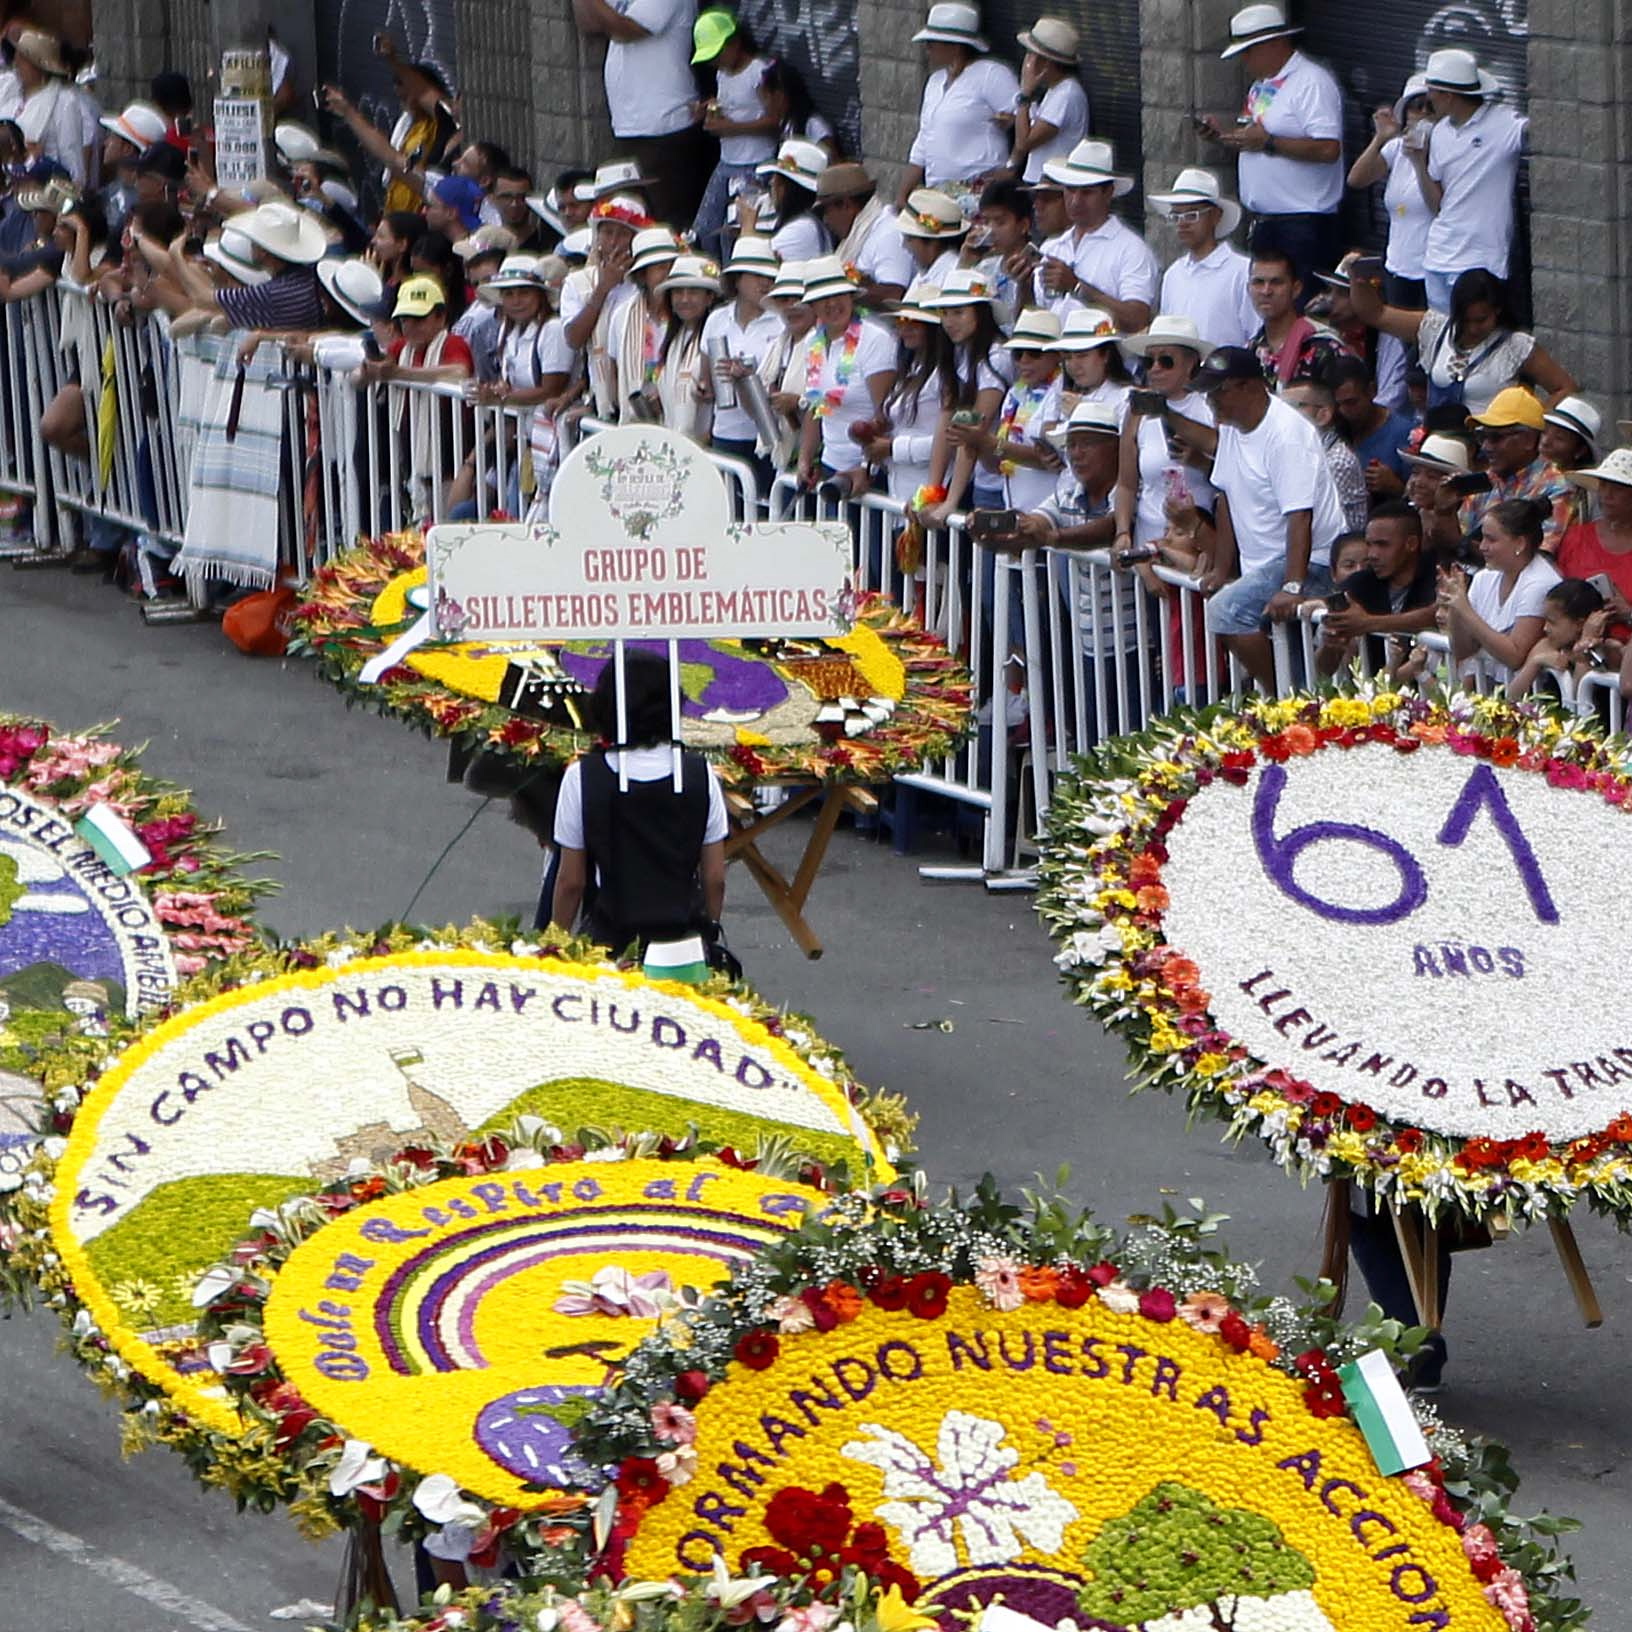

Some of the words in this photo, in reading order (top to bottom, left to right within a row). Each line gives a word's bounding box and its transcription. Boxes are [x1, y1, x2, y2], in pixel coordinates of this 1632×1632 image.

[584, 548, 666, 583] GRUPO
[676, 547, 708, 581] DE
[466, 592, 620, 630] SILLETEROS
[628, 585, 829, 627] EMBLEMÁTICAS
[1251, 763, 1560, 926] 61
[67, 850, 150, 929] MEDIO
[1412, 940, 1526, 979] AÑOS
[150, 1006, 314, 1126] CAMPO
[332, 985, 408, 1023] NO
[431, 977, 536, 1015] HAY
[1238, 968, 1448, 1100] LLEVANDO
[1474, 1078, 1537, 1108] LA
[643, 1172, 721, 1202] al
[676, 1340, 923, 1573] ORMANDO
[945, 1330, 1271, 1447] NUESTRAS
